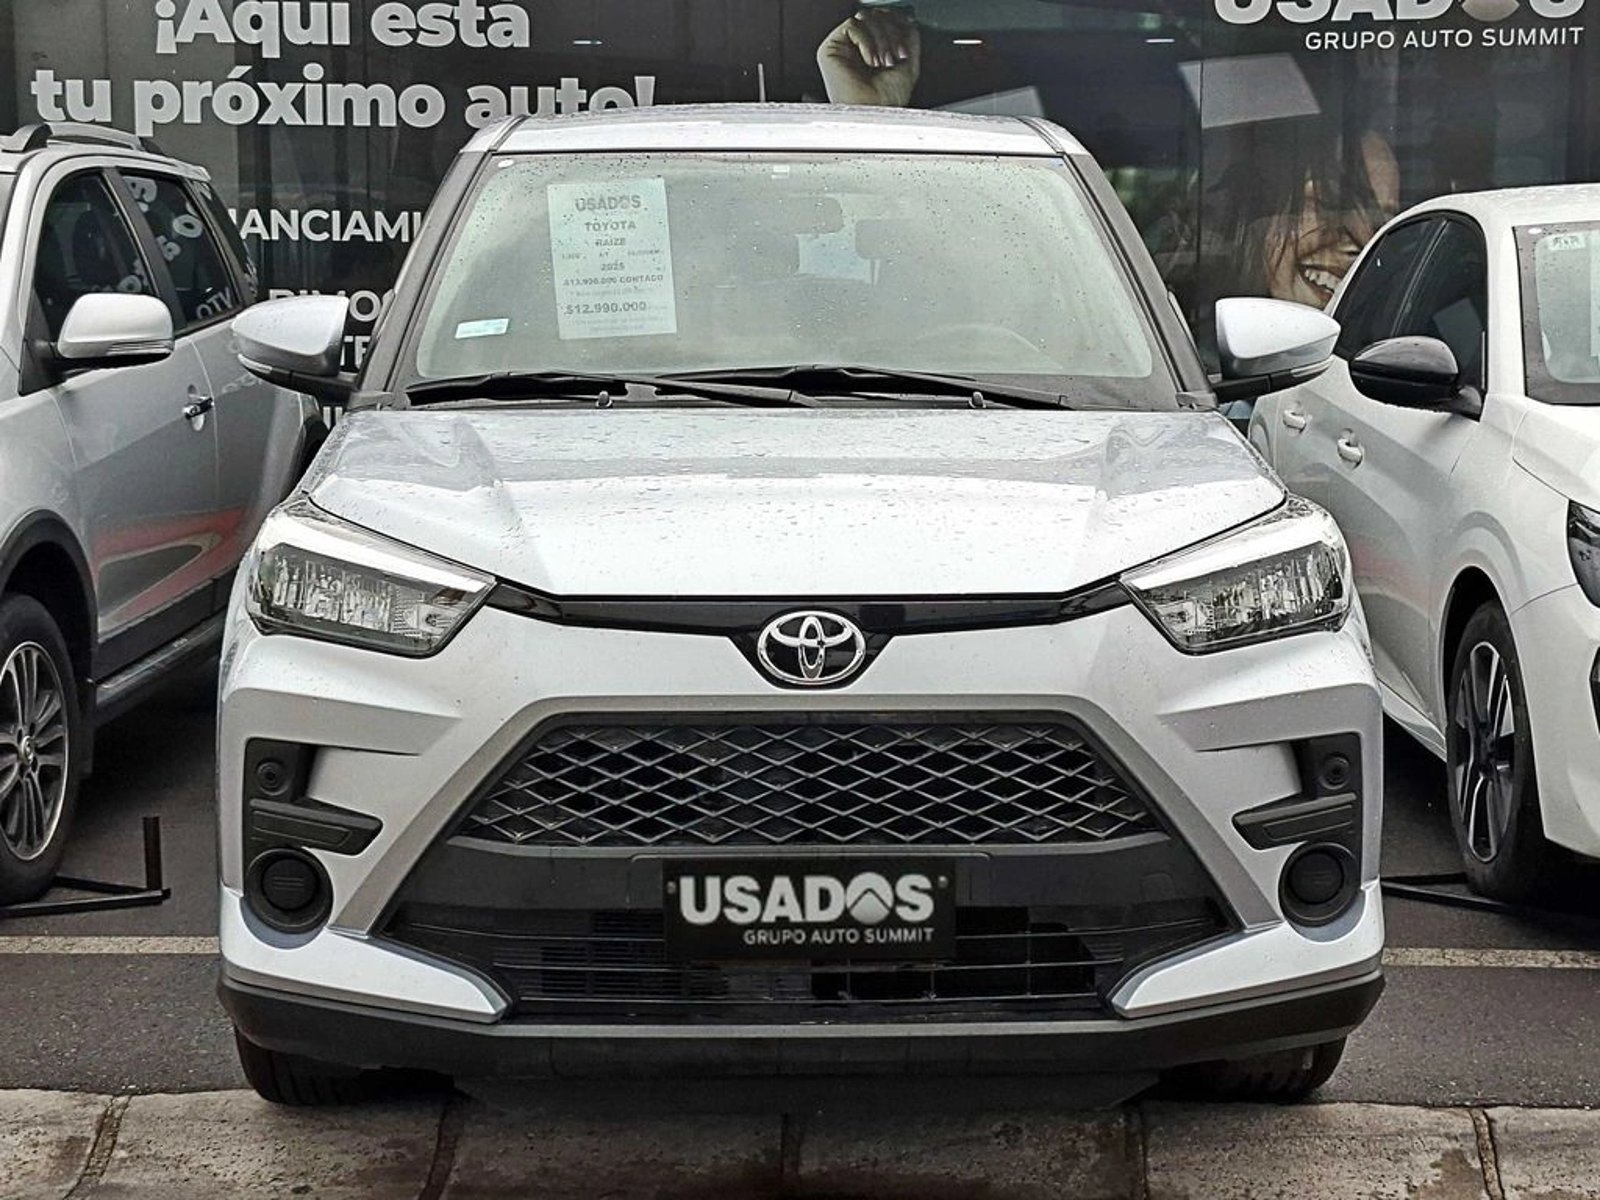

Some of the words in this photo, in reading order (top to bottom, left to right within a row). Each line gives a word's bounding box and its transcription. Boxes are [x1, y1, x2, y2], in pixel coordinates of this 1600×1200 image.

[1305, 31, 1395, 50] GRUPO
[1403, 28, 1473, 49] AUTO
[1482, 27, 1584, 47] SUMMIT
[31, 69, 112, 123] tu
[134, 63, 445, 137] próximo
[575, 194, 642, 212] USADOS
[584, 220, 637, 232] TOYOTA
[679, 871, 935, 925] USADOS
[743, 928, 806, 945] GRUPO
[810, 927, 860, 944] AUTO
[864, 927, 935, 943] SUMMIT
